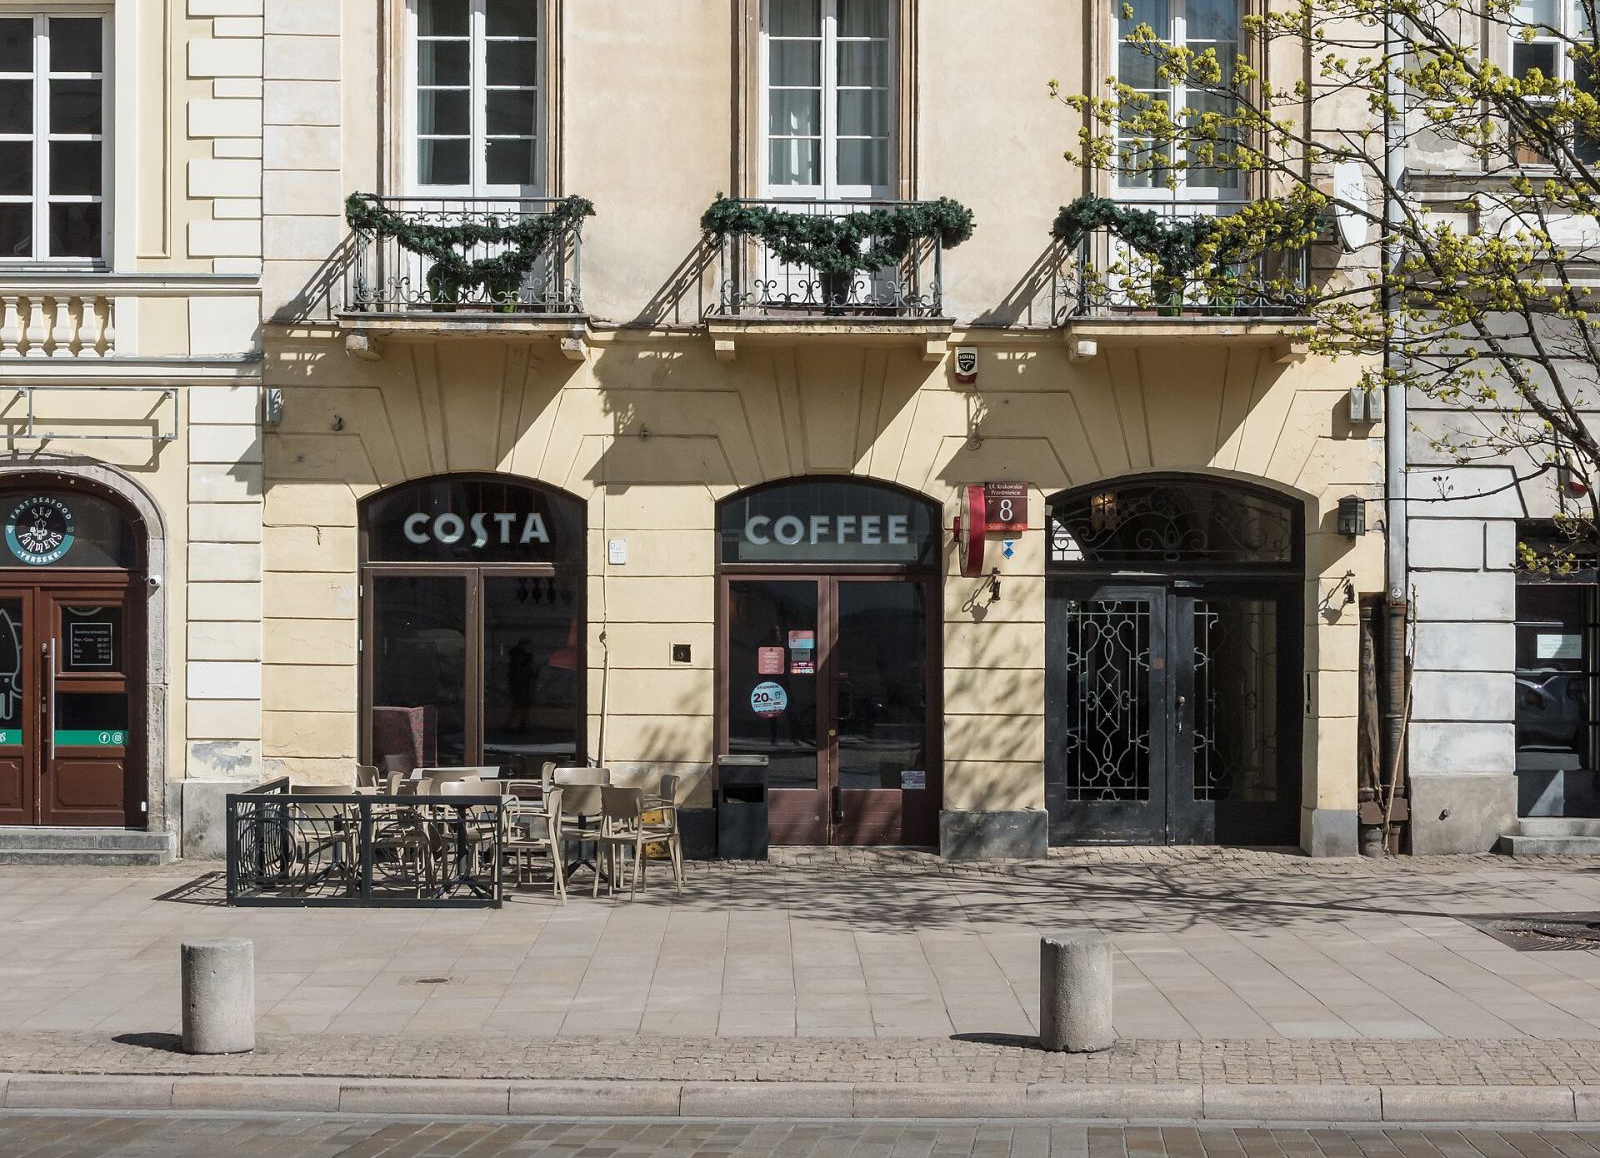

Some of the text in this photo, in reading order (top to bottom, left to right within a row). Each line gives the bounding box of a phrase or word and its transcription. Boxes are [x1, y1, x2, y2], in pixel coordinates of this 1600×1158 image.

[10, 497, 72, 520] FAST SEAFOOD
[1000, 499, 1013, 521] 8
[403, 512, 550, 548] COSTA
[745, 515, 909, 546] COFFEE
[20, 552, 59, 562] YERSEKE
